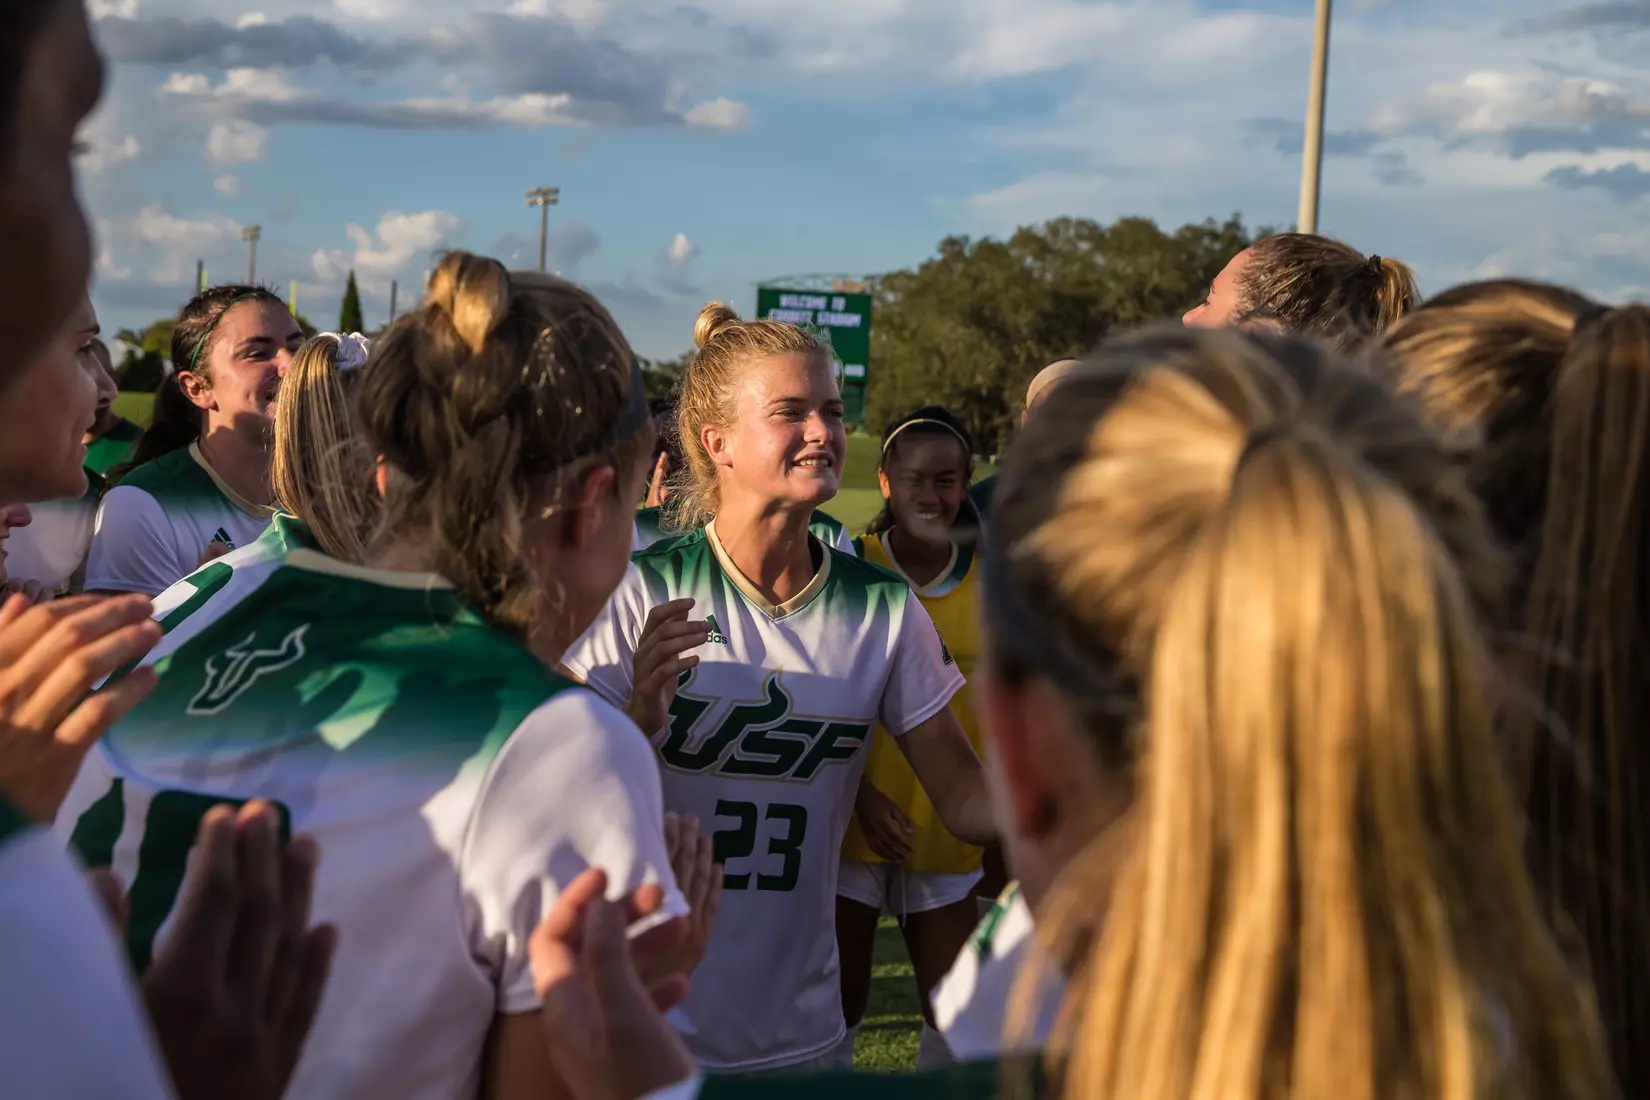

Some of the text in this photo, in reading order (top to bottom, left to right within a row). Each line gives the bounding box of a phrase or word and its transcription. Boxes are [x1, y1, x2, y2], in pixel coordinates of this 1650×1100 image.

[780, 294, 846, 311] WELCOME TO
[817, 311, 862, 327] STADIUM
[707, 632, 728, 644] das
[657, 664, 877, 784] USF
[713, 799, 807, 892] 23
